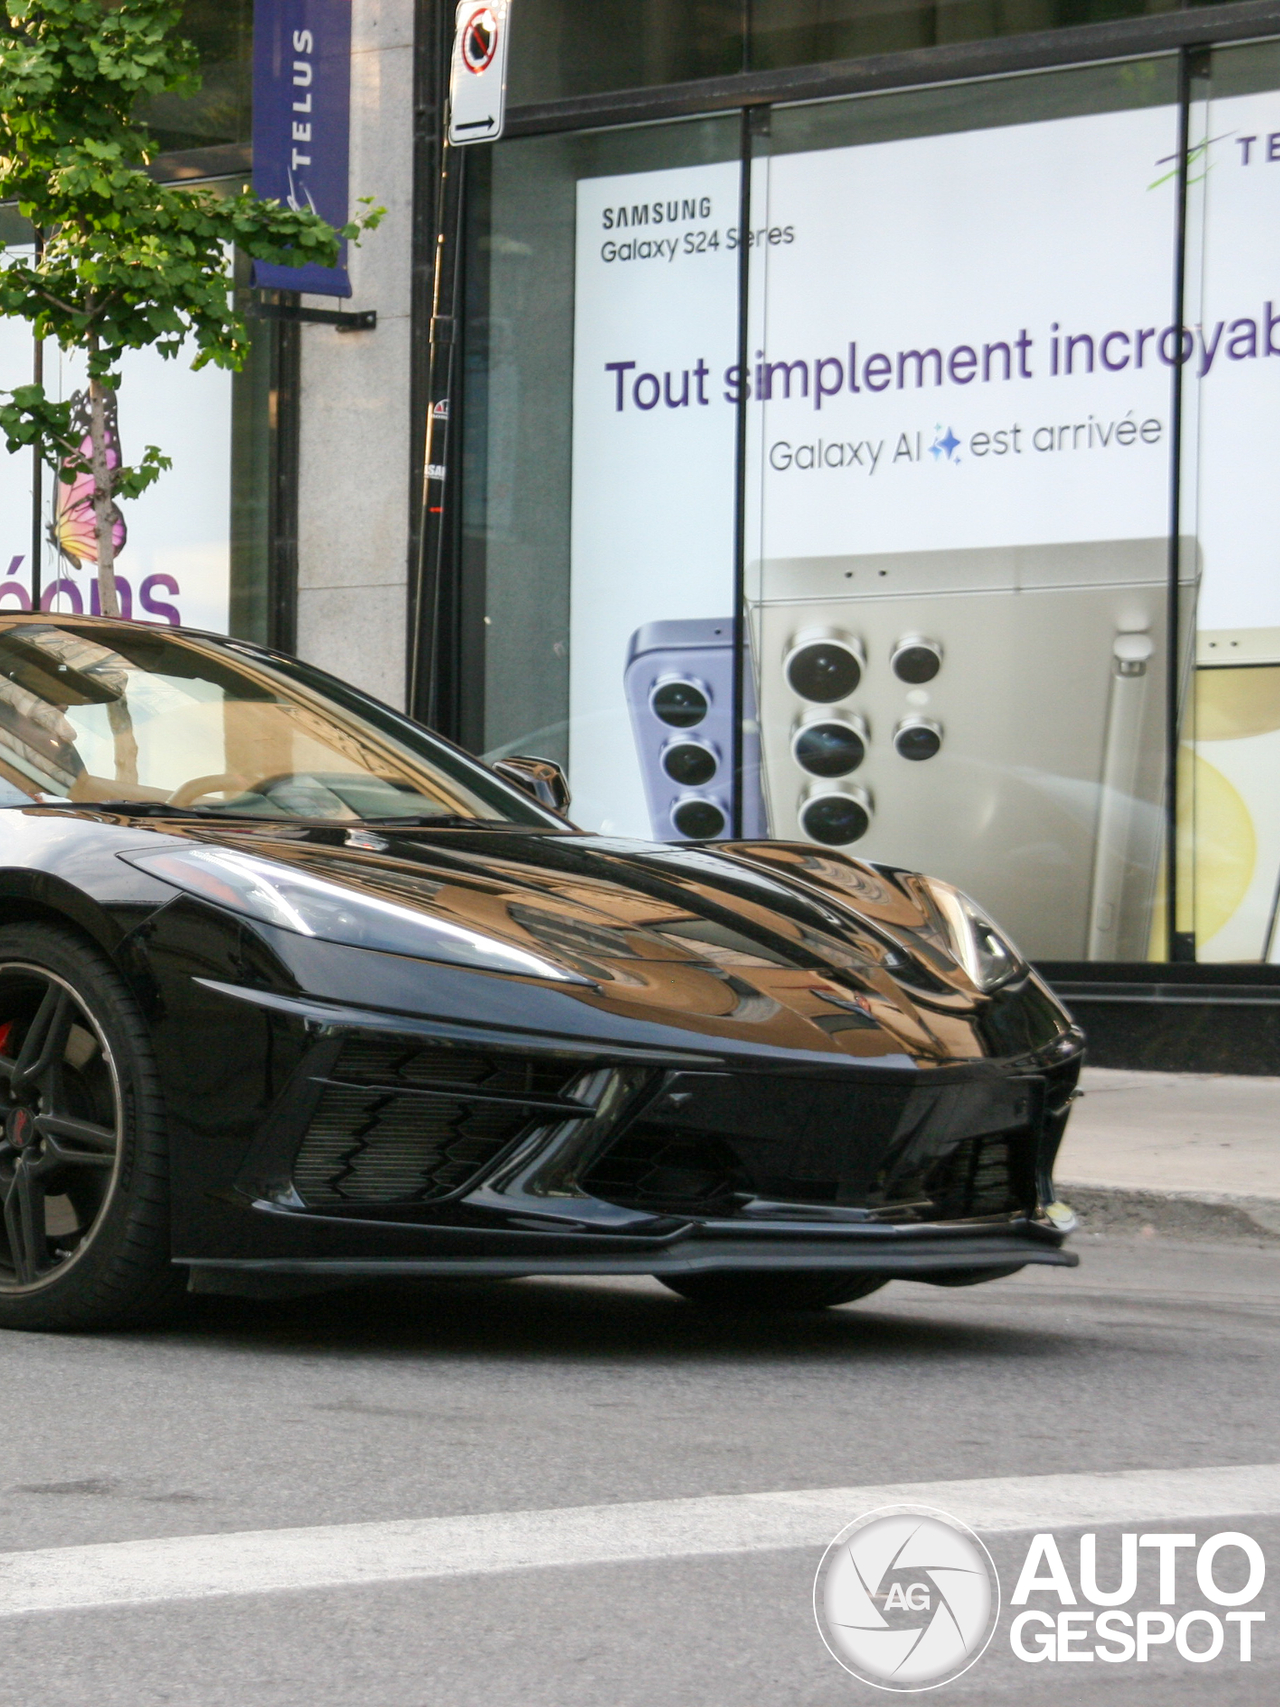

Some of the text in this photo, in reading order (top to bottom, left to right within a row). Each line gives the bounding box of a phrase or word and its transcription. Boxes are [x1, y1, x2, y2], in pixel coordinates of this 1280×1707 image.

[292, 29, 313, 171] TELUS
[601, 225, 795, 263] Galaxy S24 Seres
[602, 197, 711, 229] SAMSUNG
[605, 357, 710, 412] Tout
[722, 328, 1033, 411] simplement
[769, 409, 1163, 476] Galaxy AI est arrivée
